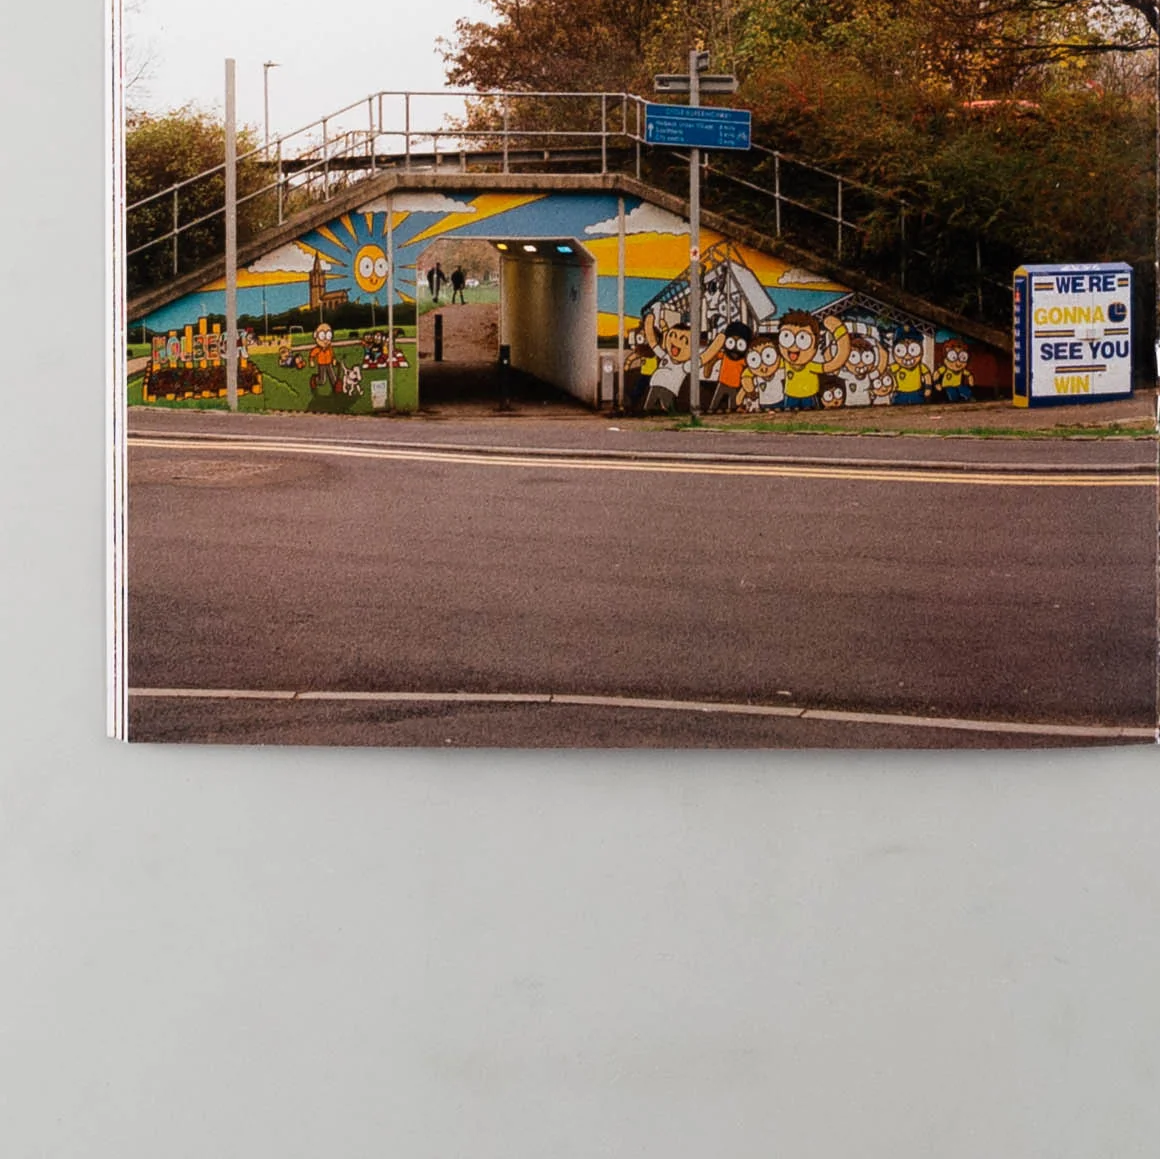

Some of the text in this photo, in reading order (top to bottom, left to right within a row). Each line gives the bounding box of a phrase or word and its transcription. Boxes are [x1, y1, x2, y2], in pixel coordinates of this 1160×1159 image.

[1034, 306, 1105, 325] GONNA
[1040, 340, 1130, 361] SEE YOU
[1054, 375, 1090, 394] WIN
